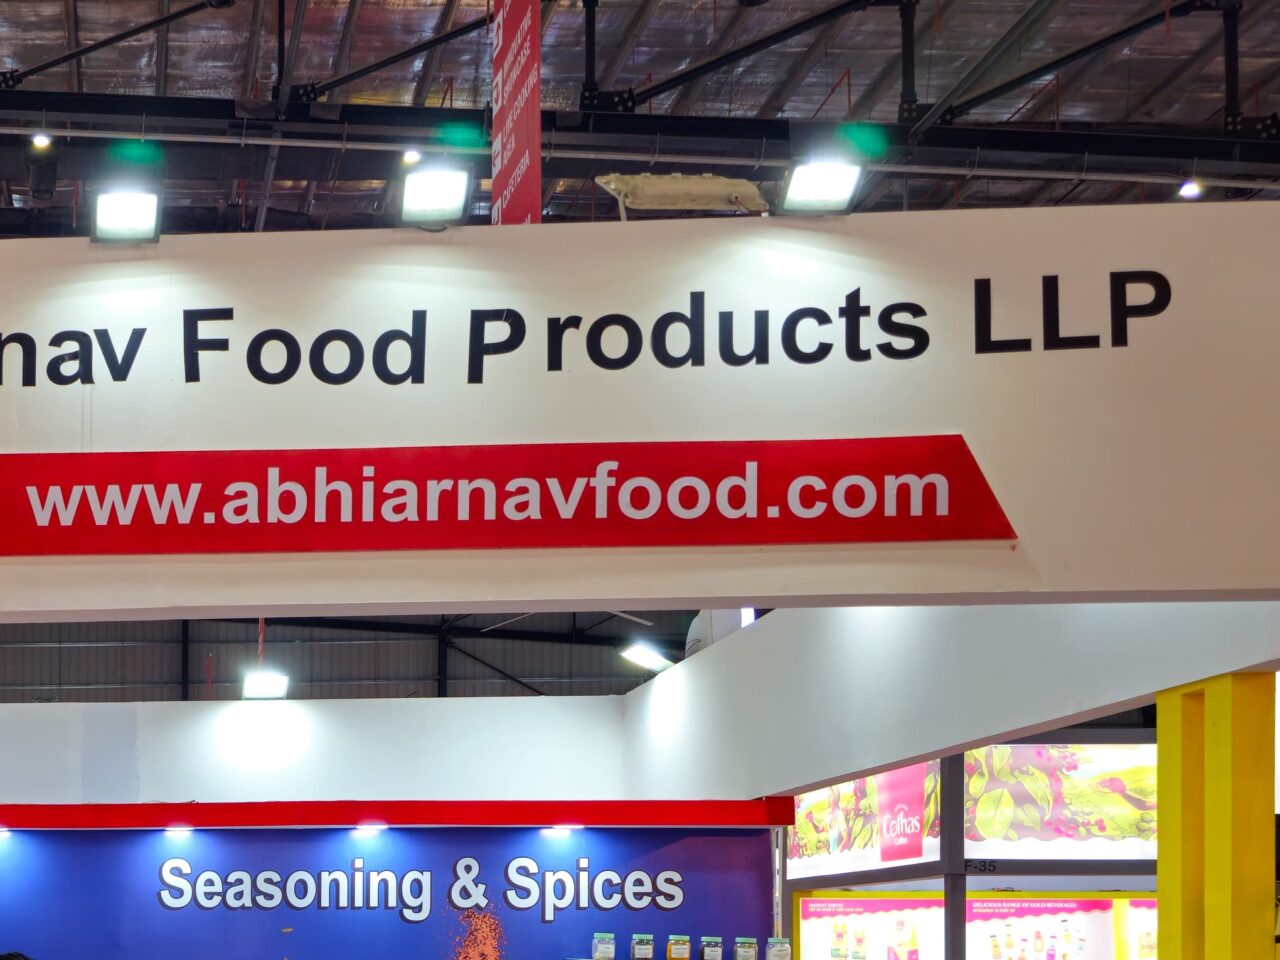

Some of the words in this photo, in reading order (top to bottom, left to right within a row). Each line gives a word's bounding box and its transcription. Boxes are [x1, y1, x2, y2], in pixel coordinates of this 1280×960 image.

[502, 149, 530, 209] CAFETERIA
[182, 307, 428, 385] Food
[467, 286, 931, 384] Products
[974, 270, 1172, 354] LLP
[26, 461, 949, 527] www.abhiarnavfood.com
[160, 858, 431, 922] Seasoning
[449, 858, 489, 909] &
[506, 858, 684, 922] Spices
[964, 861, 997, 872] F-35
